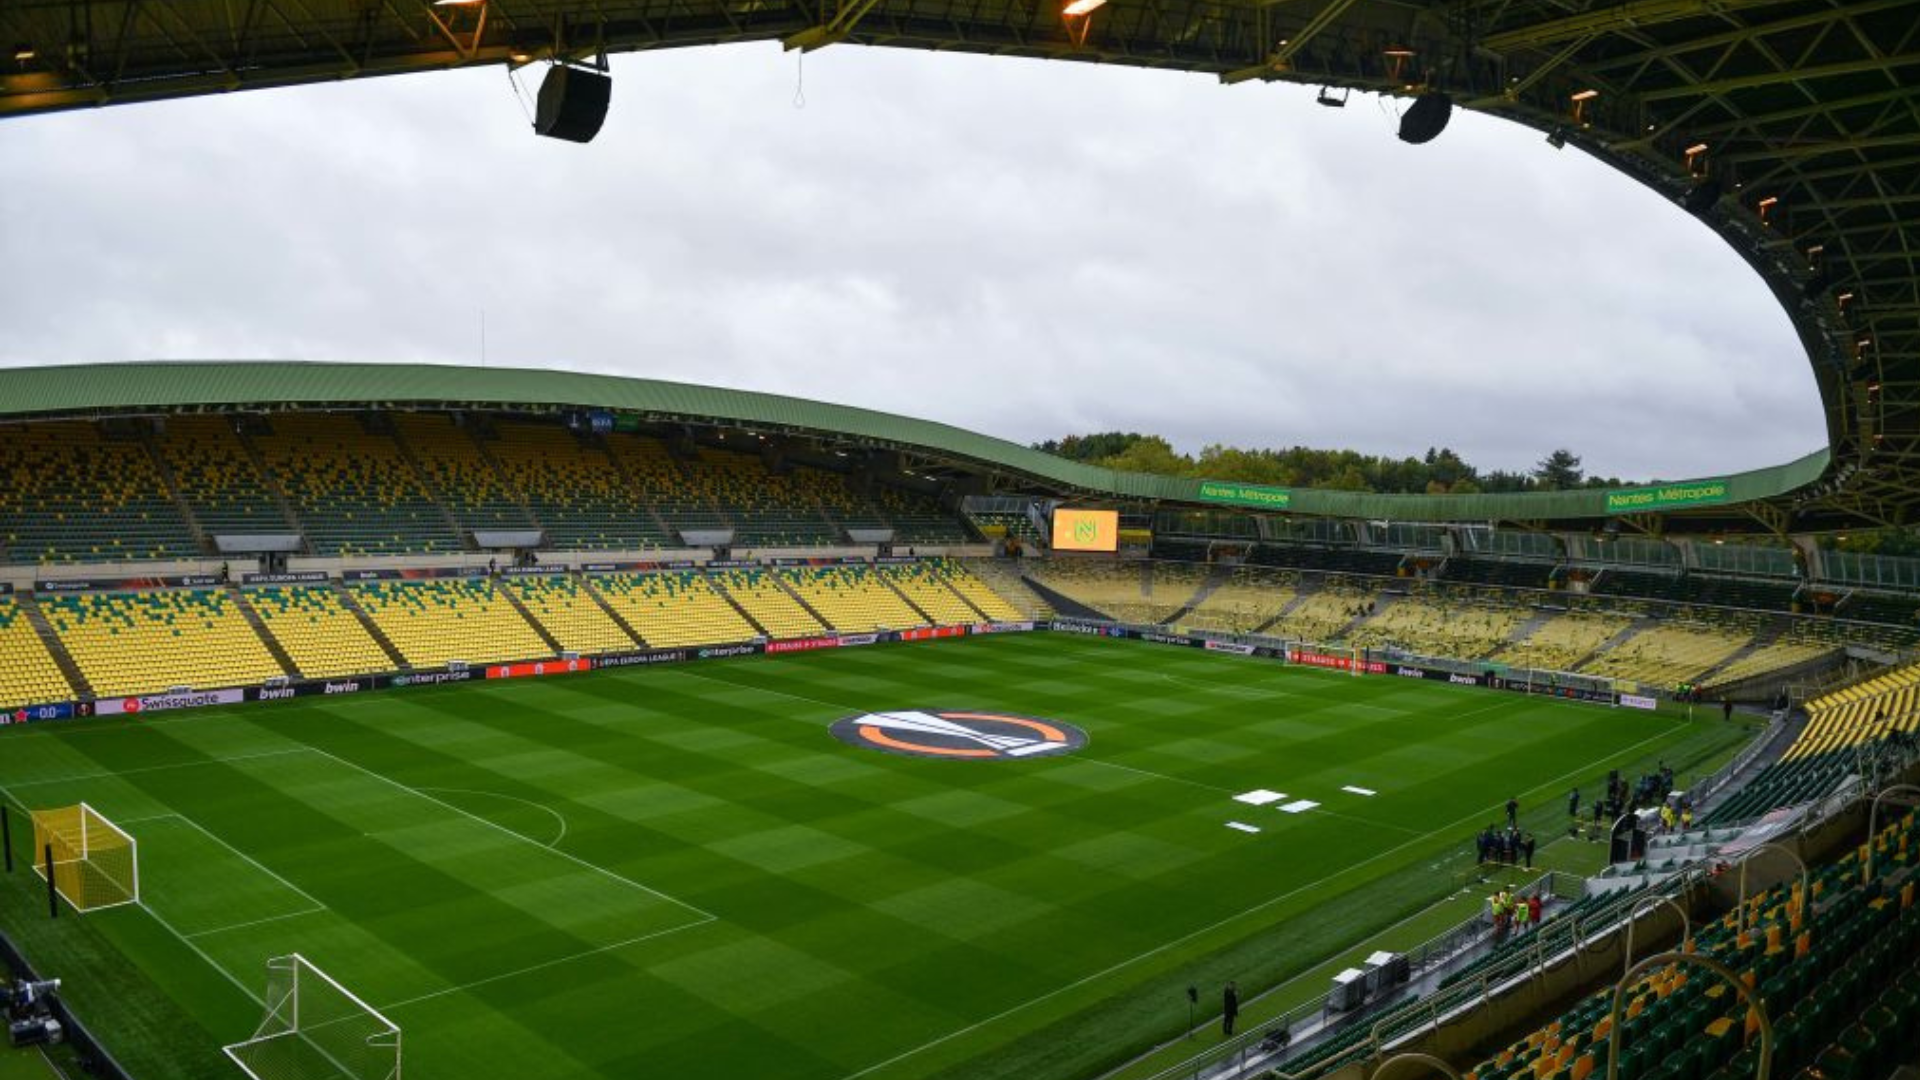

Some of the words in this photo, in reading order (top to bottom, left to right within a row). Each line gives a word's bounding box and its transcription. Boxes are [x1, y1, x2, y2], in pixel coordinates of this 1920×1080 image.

[1201, 484, 1236, 498] Nantes
[1609, 494, 1654, 506] Nantes
[1658, 485, 1725, 501] Métropole
[1449, 673, 1476, 685] bwin
[259, 683, 295, 700] bwin
[323, 680, 359, 694] bwin
[142, 692, 219, 709] Swissquote
